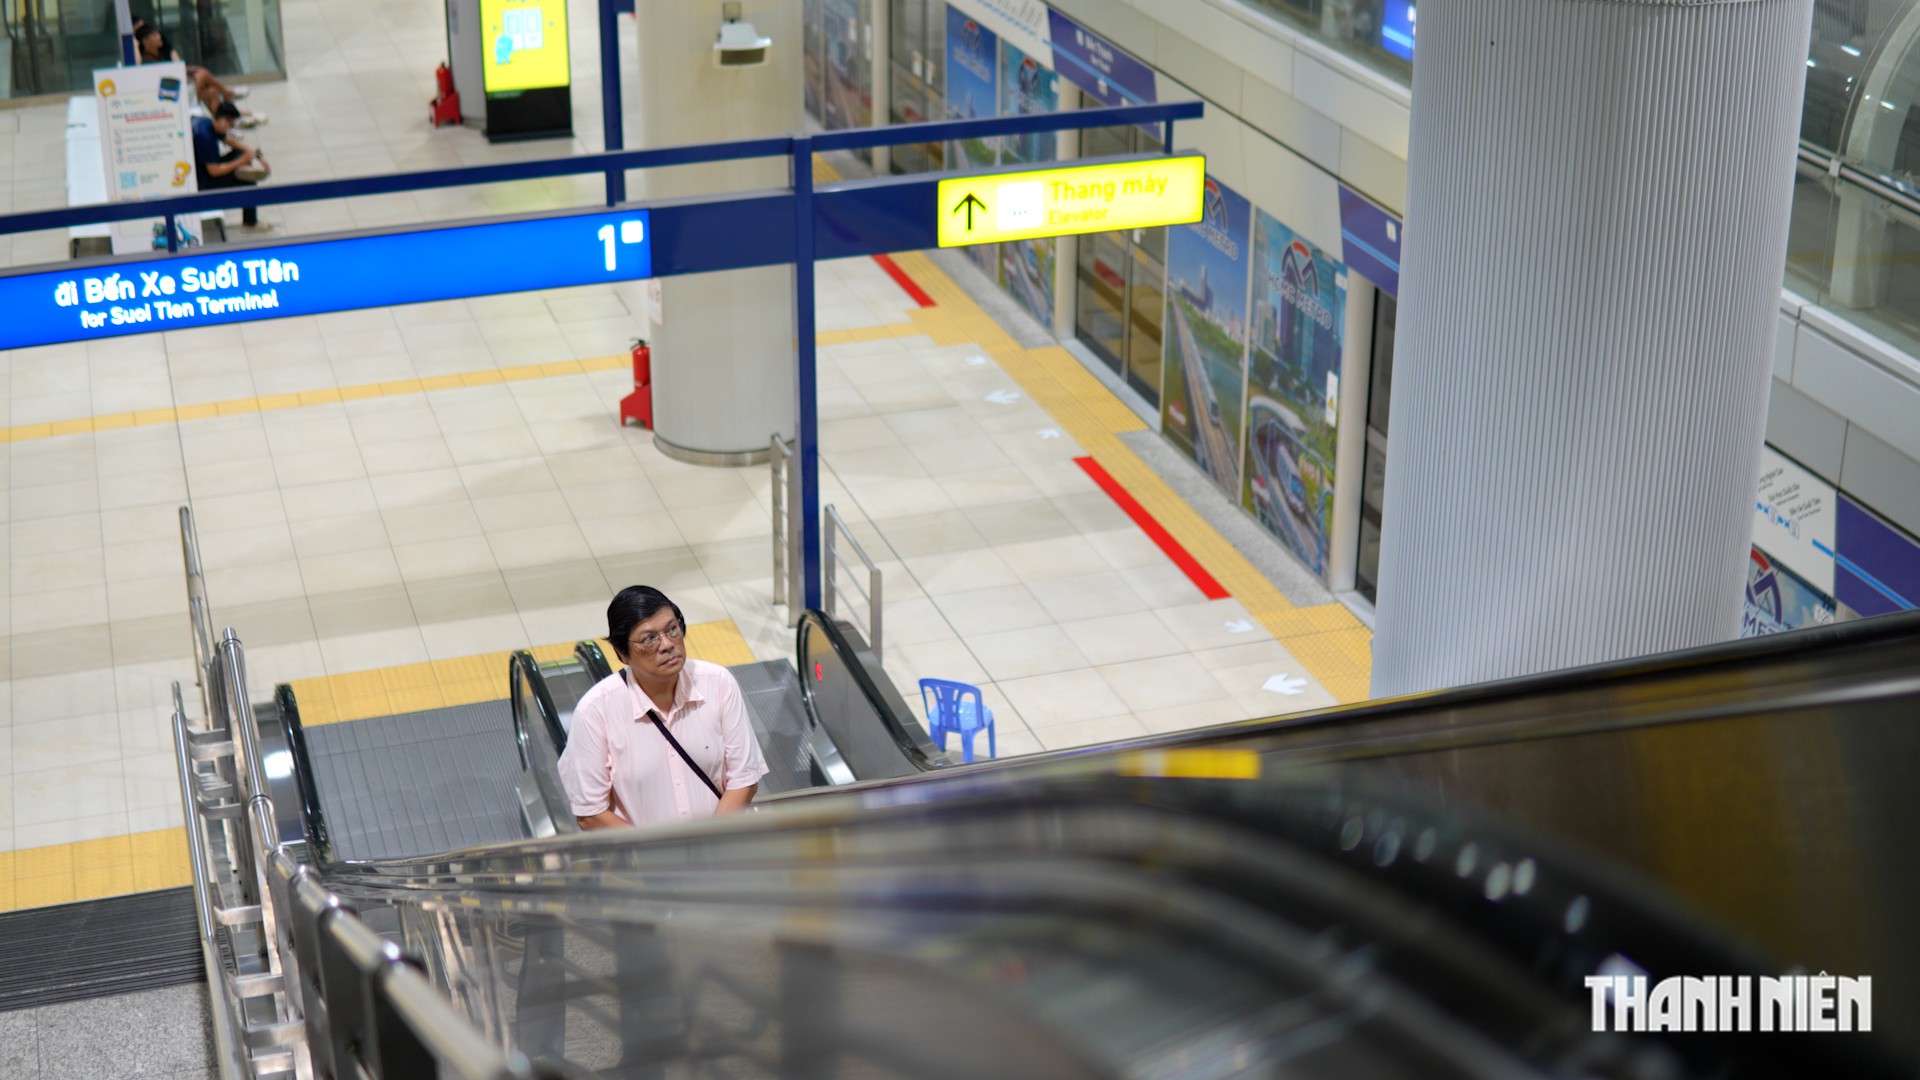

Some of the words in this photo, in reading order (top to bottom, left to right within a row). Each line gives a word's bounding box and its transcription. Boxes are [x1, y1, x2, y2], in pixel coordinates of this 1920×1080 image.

[1050, 180, 1115, 203] Thang
[1122, 173, 1168, 197] máy
[1049, 208, 1108, 225] Elevator
[598, 224, 616, 271] 1
[55, 280, 78, 306] đi
[84, 273, 135, 303] Bến
[140, 271, 176, 297] Xe
[181, 260, 239, 293] Suối
[243, 258, 299, 287] Tiên
[80, 310, 107, 329] for
[110, 303, 151, 326] Suoi
[154, 299, 194, 320] Tien
[197, 289, 279, 315] Terminal
